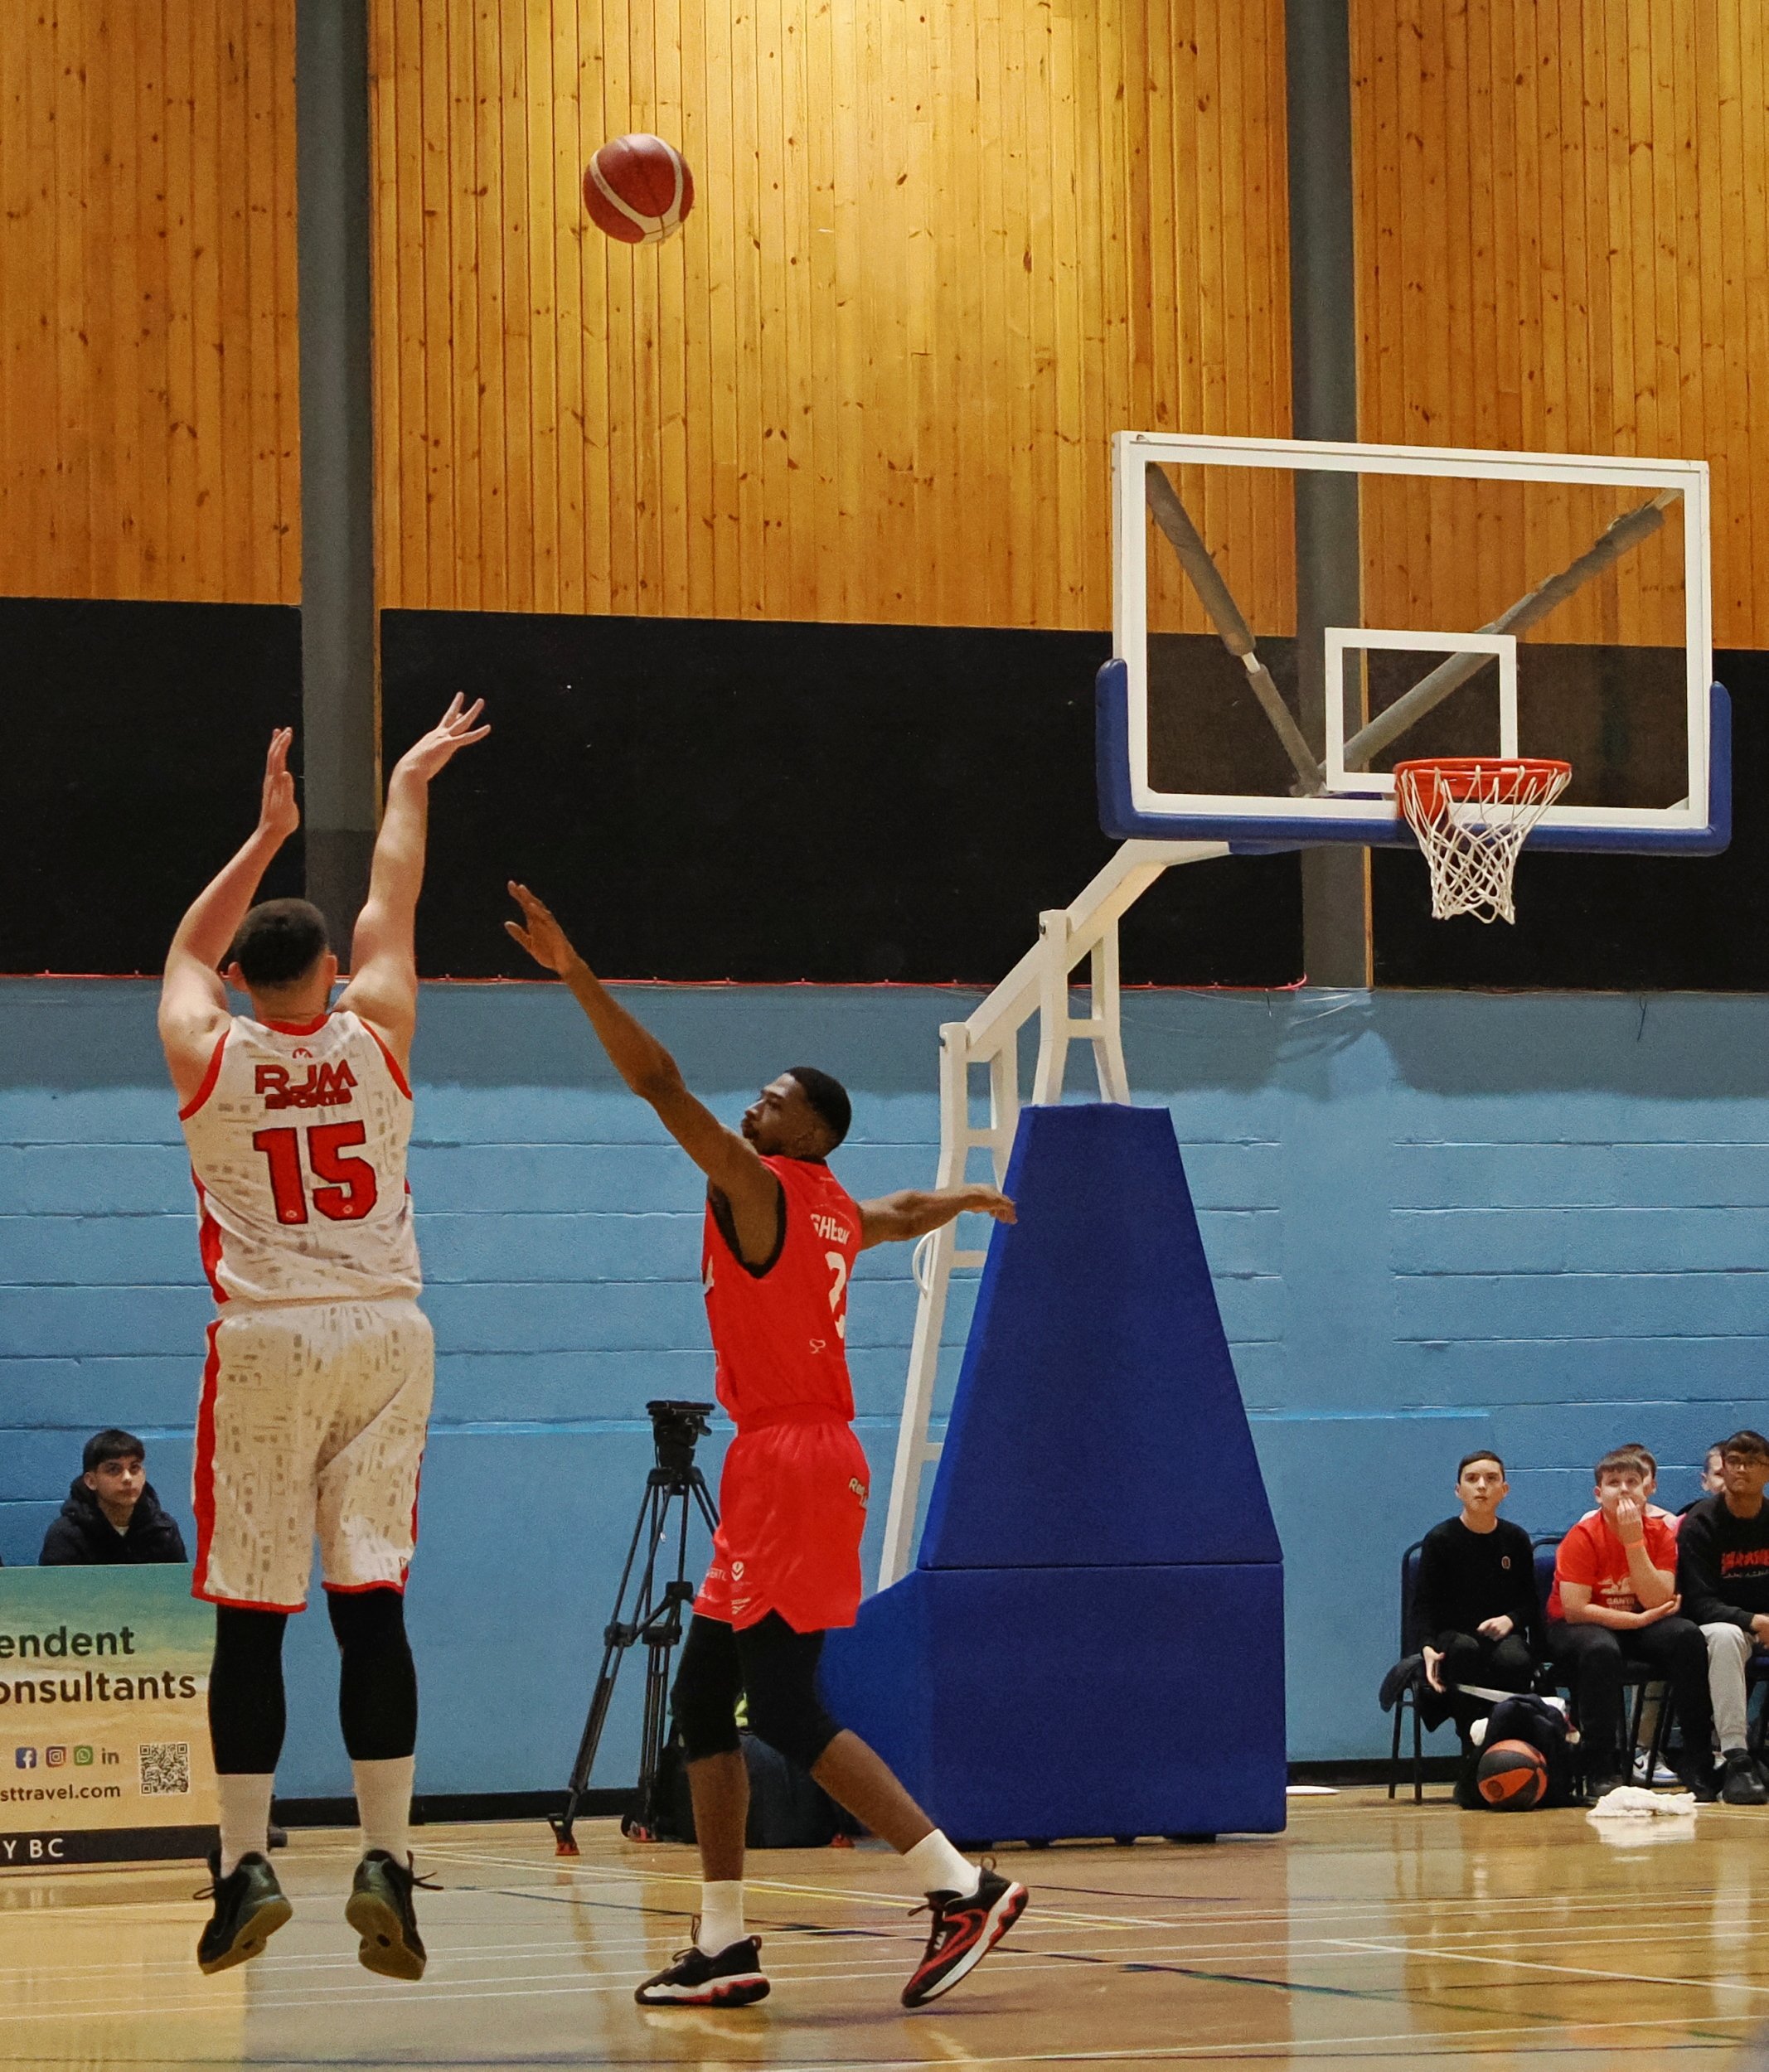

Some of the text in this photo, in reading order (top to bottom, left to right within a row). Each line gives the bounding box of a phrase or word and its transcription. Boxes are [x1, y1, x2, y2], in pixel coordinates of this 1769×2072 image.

[254, 1058, 359, 1094] RJM
[252, 1119, 378, 1225] 15
[0, 1625, 134, 1658] endent
[0, 1784, 121, 1802] sttravel.com
[2, 1838, 65, 1859] Y BC
